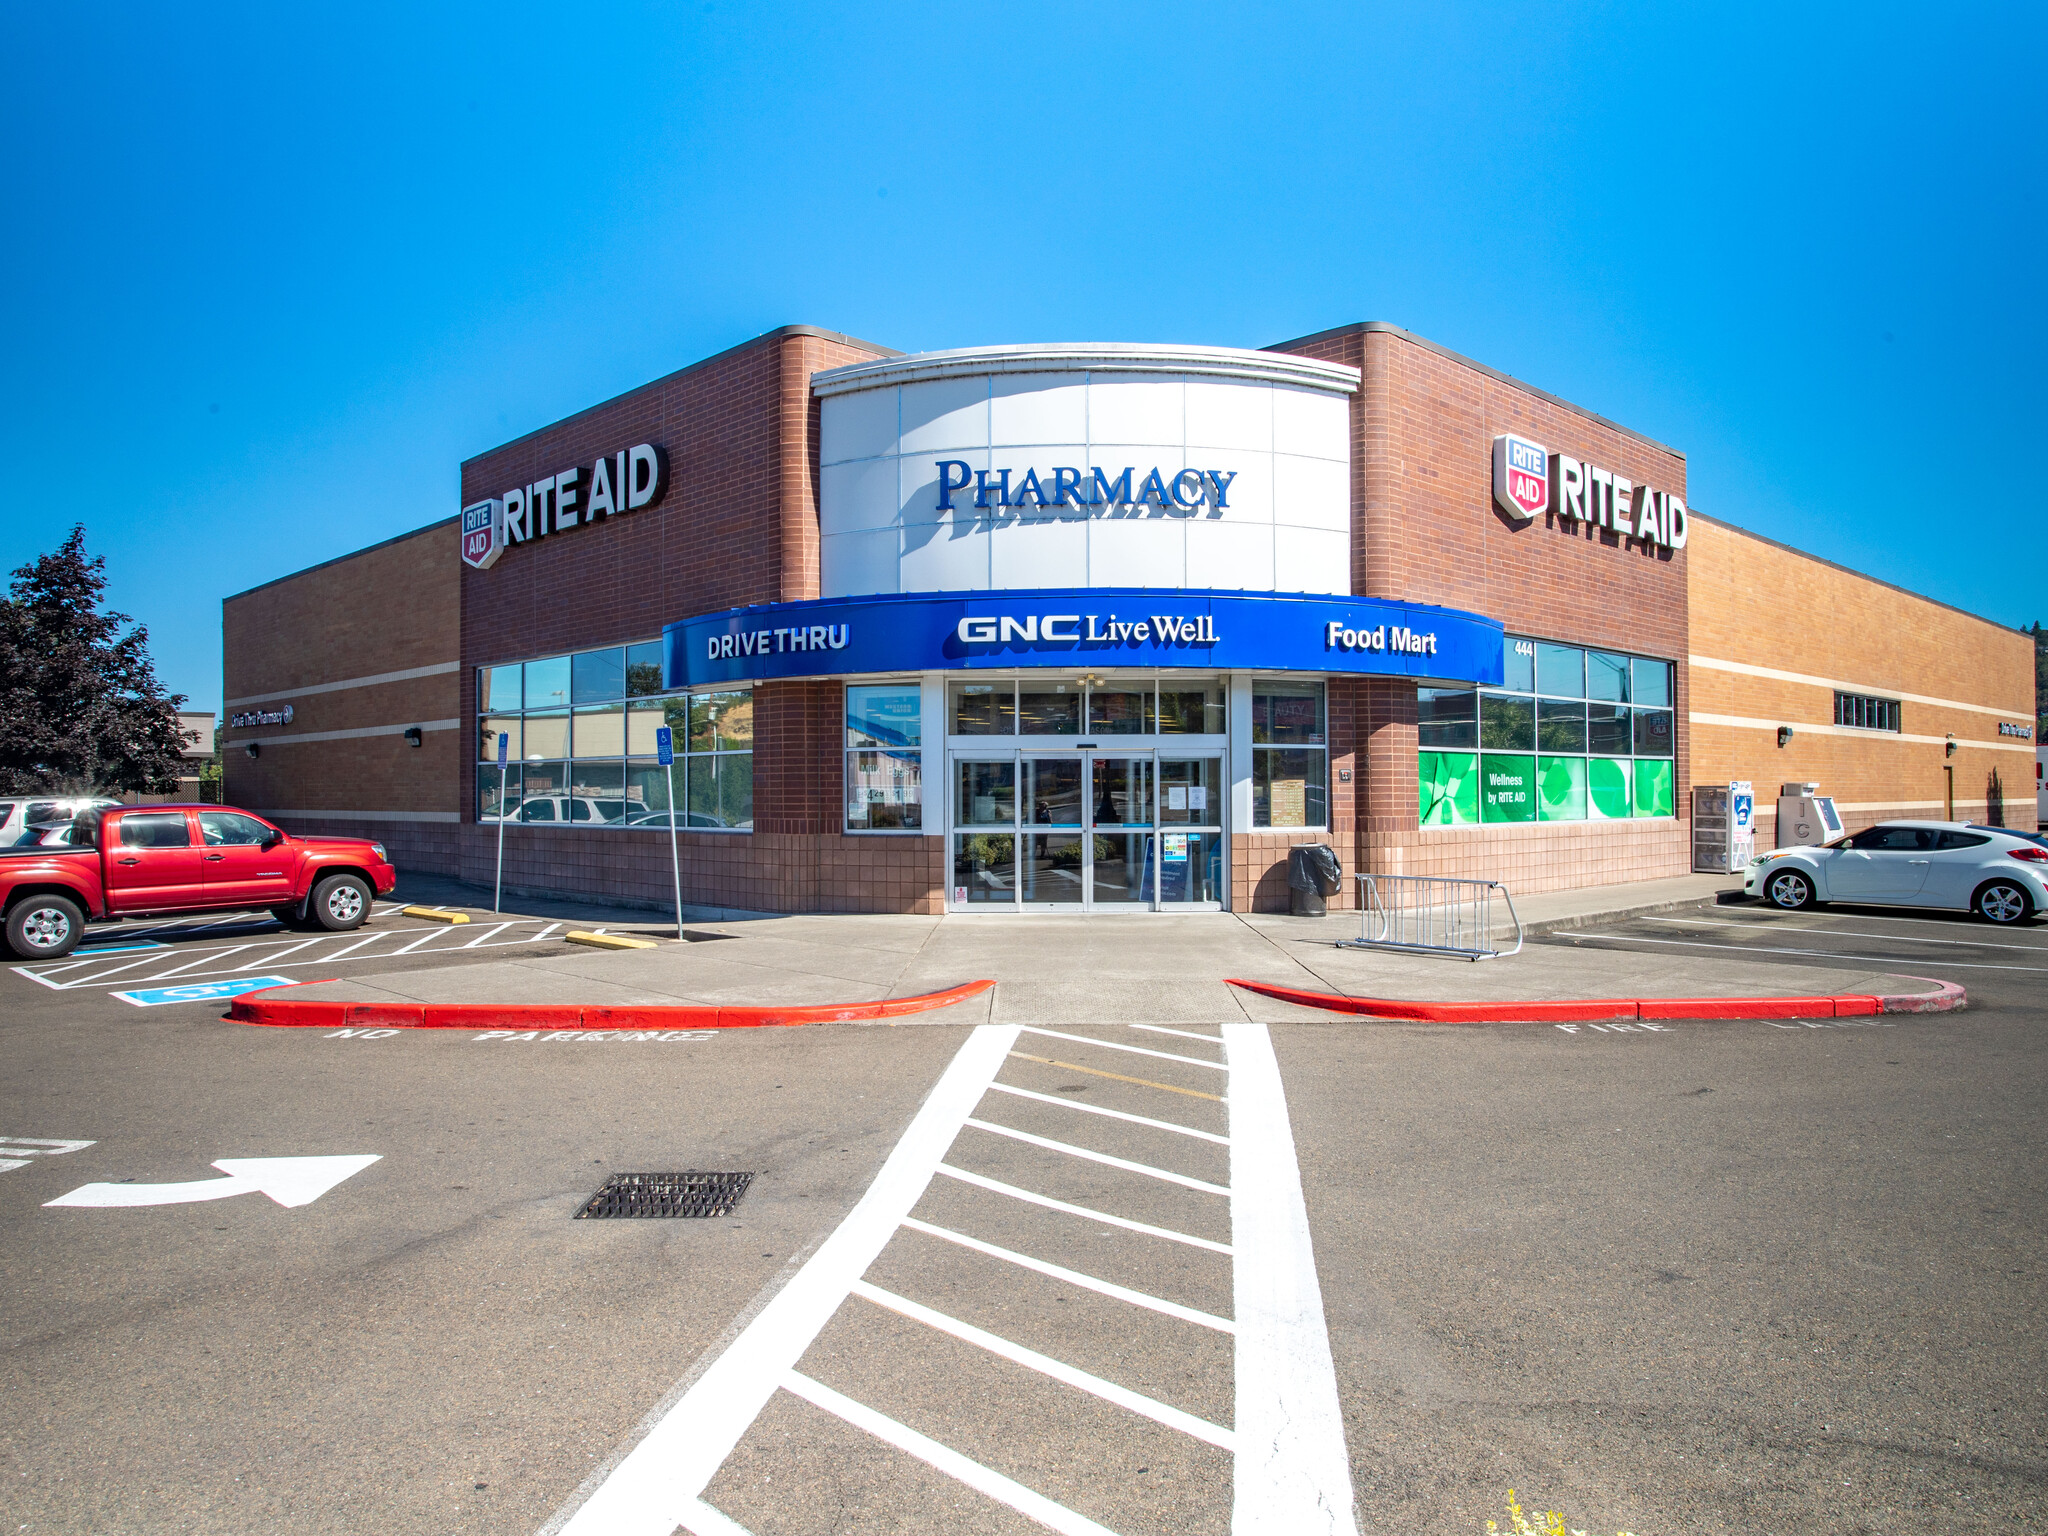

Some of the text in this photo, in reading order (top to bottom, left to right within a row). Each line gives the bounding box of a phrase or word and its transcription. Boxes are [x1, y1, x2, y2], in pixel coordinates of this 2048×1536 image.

[1513, 443, 1542, 472] RITE
[503, 444, 659, 546] RITE AID
[935, 459, 1237, 511] PHARMACY
[1515, 476, 1539, 503] AID
[1559, 453, 1688, 549] RITE AID
[466, 506, 489, 530] RITE
[468, 533, 487, 556] AID
[957, 615, 1080, 643] GNC
[1085, 614, 1150, 641] Live
[1328, 622, 1437, 654] Food Mart
[708, 624, 849, 659] DRIVE THRU
[1515, 641, 1533, 656] 444
[888, 765, 910, 777] Eggs
[1489, 773, 1523, 786] Wellness
[1487, 791, 1526, 805] by RITE AID
[323, 1028, 401, 1039] NO
[1554, 1022, 1677, 1034] FIRE
